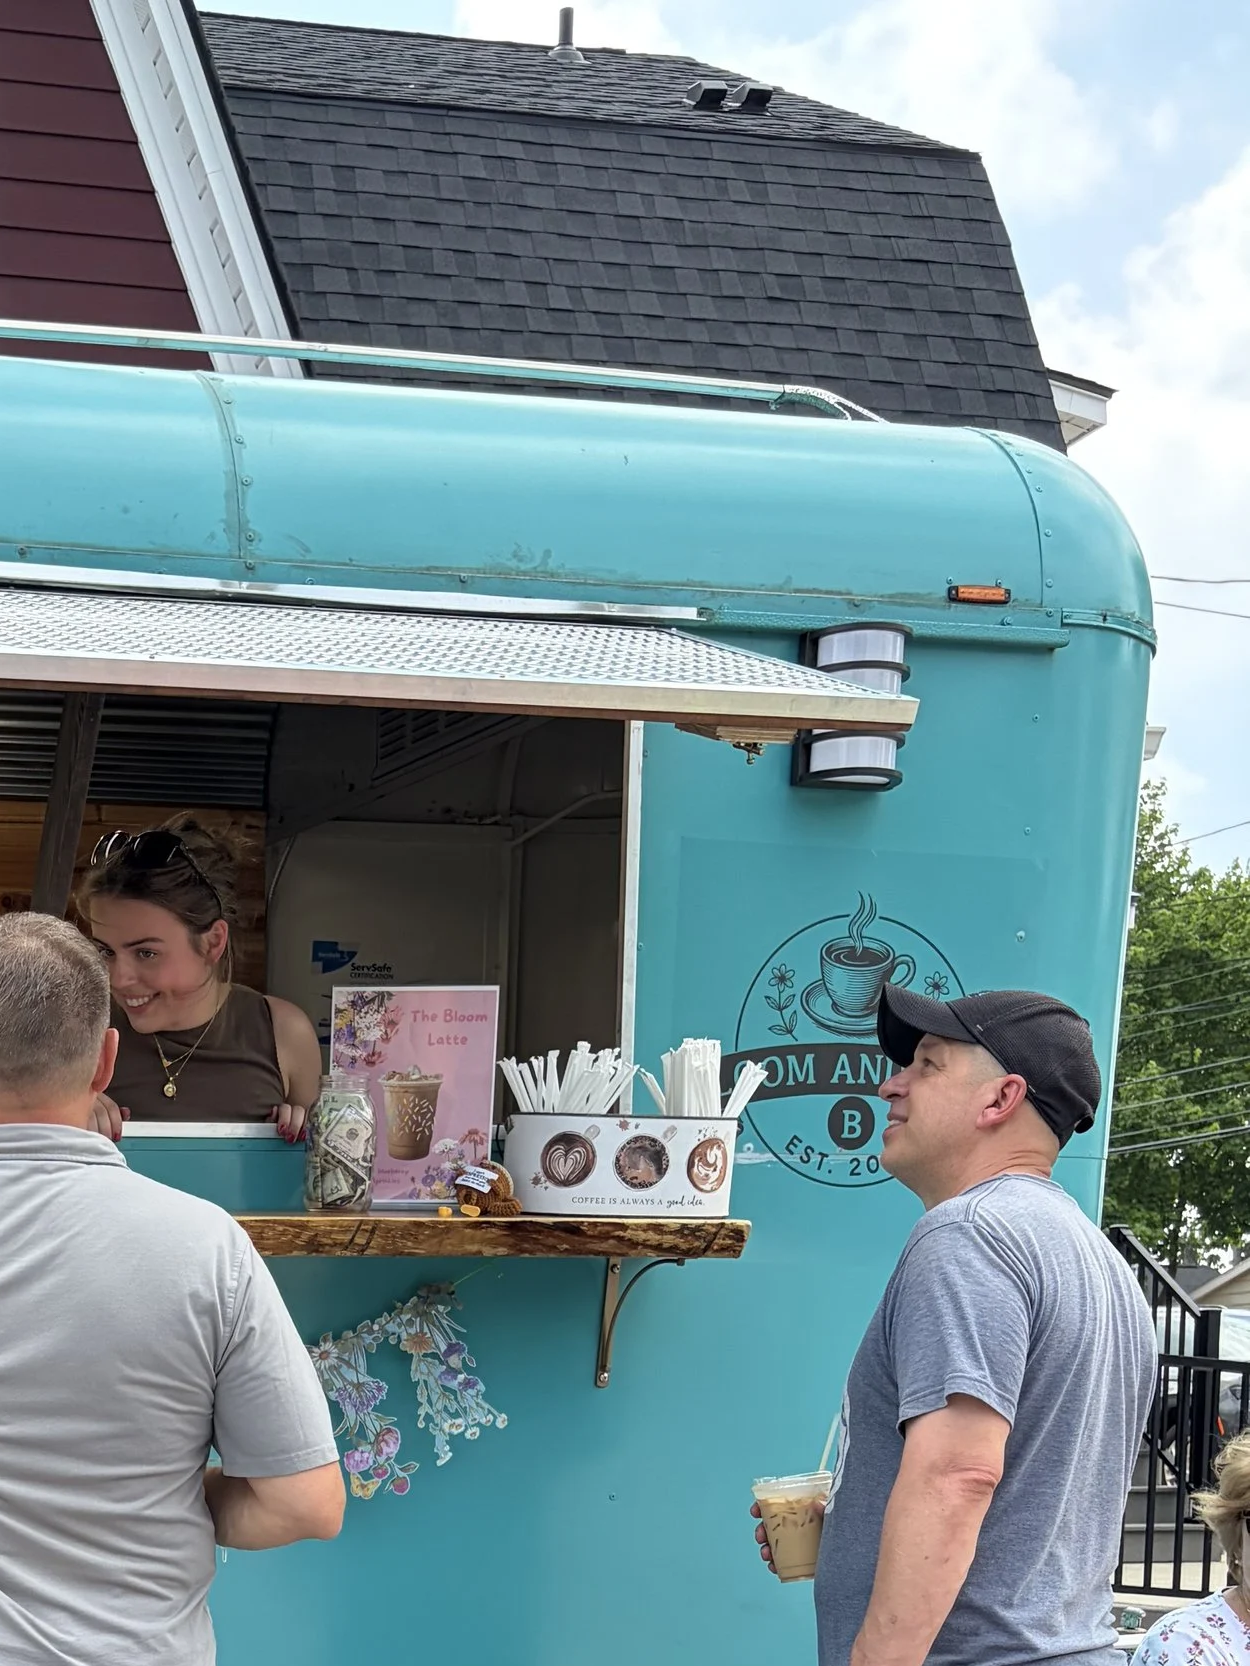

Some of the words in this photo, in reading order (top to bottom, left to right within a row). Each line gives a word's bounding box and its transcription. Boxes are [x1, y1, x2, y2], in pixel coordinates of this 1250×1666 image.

[351, 963, 392, 973] ServSafe
[411, 1010, 439, 1023] The
[443, 1009, 488, 1023] Bloom
[427, 1033, 469, 1046] Latte
[841, 1110, 862, 1139] B
[785, 1134, 832, 1174] EST.
[571, 1196, 605, 1204] COFFEE
